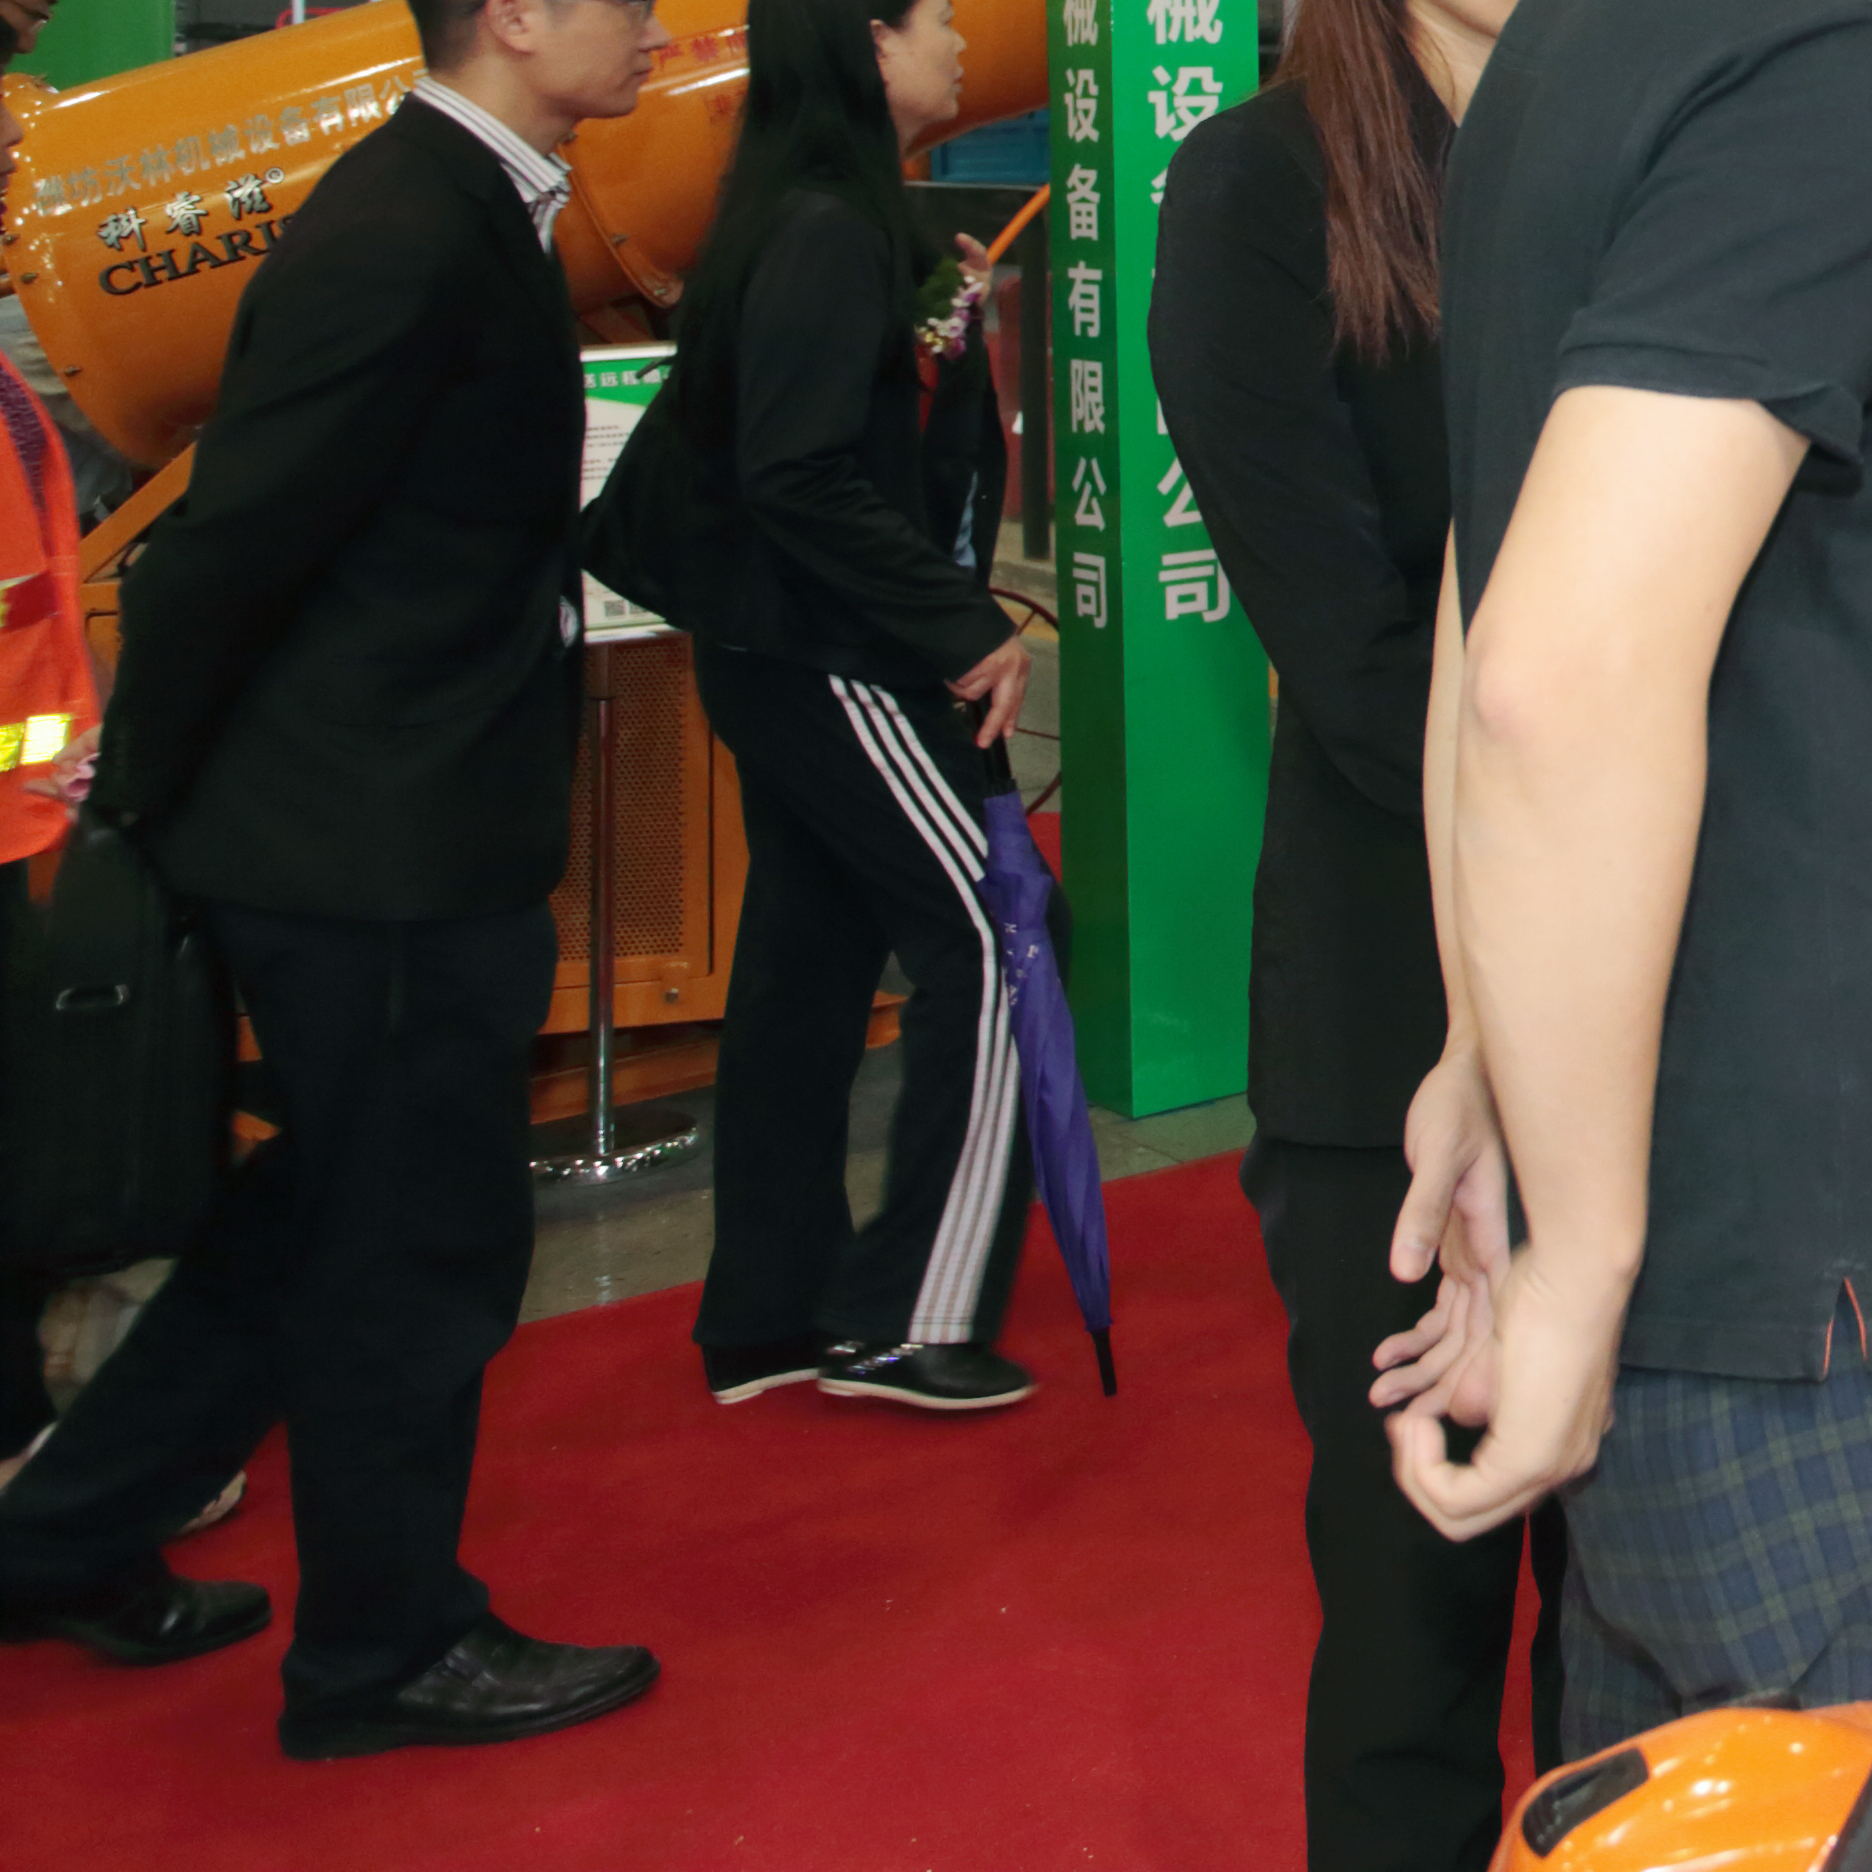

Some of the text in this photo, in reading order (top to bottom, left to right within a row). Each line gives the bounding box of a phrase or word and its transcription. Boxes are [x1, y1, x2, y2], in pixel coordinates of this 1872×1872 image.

[34, 70, 426, 216] 潍坊沃林机械设备有限公
